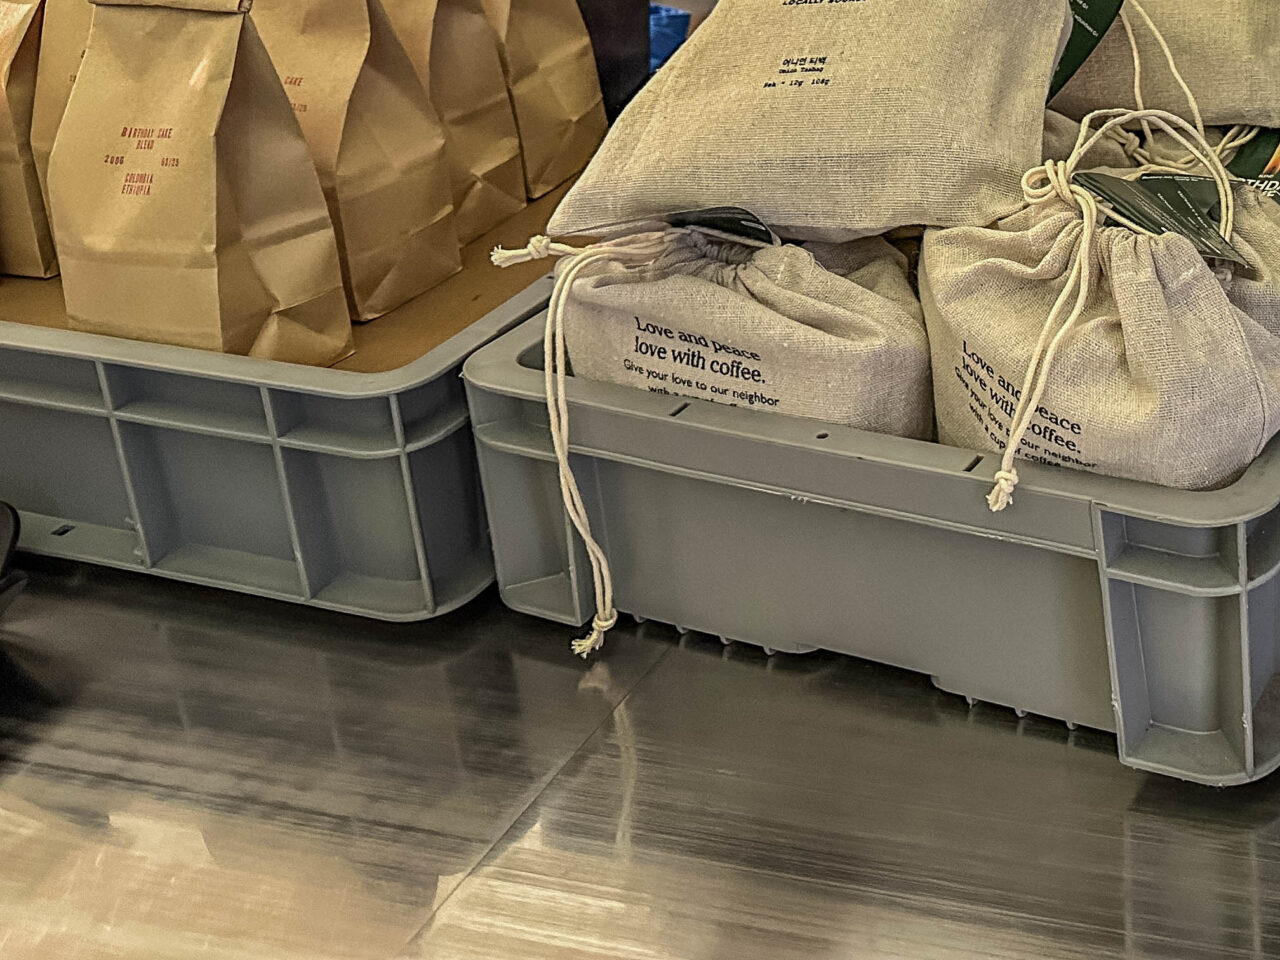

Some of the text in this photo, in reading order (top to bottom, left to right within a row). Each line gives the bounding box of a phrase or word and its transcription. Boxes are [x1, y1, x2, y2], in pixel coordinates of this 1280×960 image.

[634, 316, 761, 362] Love and peace
[634, 336, 766, 384] love with coffee.
[962, 340, 995, 379] Love
[623, 358, 780, 407] Give your love to our neighbor
[961, 356, 1017, 418] love with
[954, 366, 1098, 469] Give love our neighbor
[968, 402, 984, 424] with
